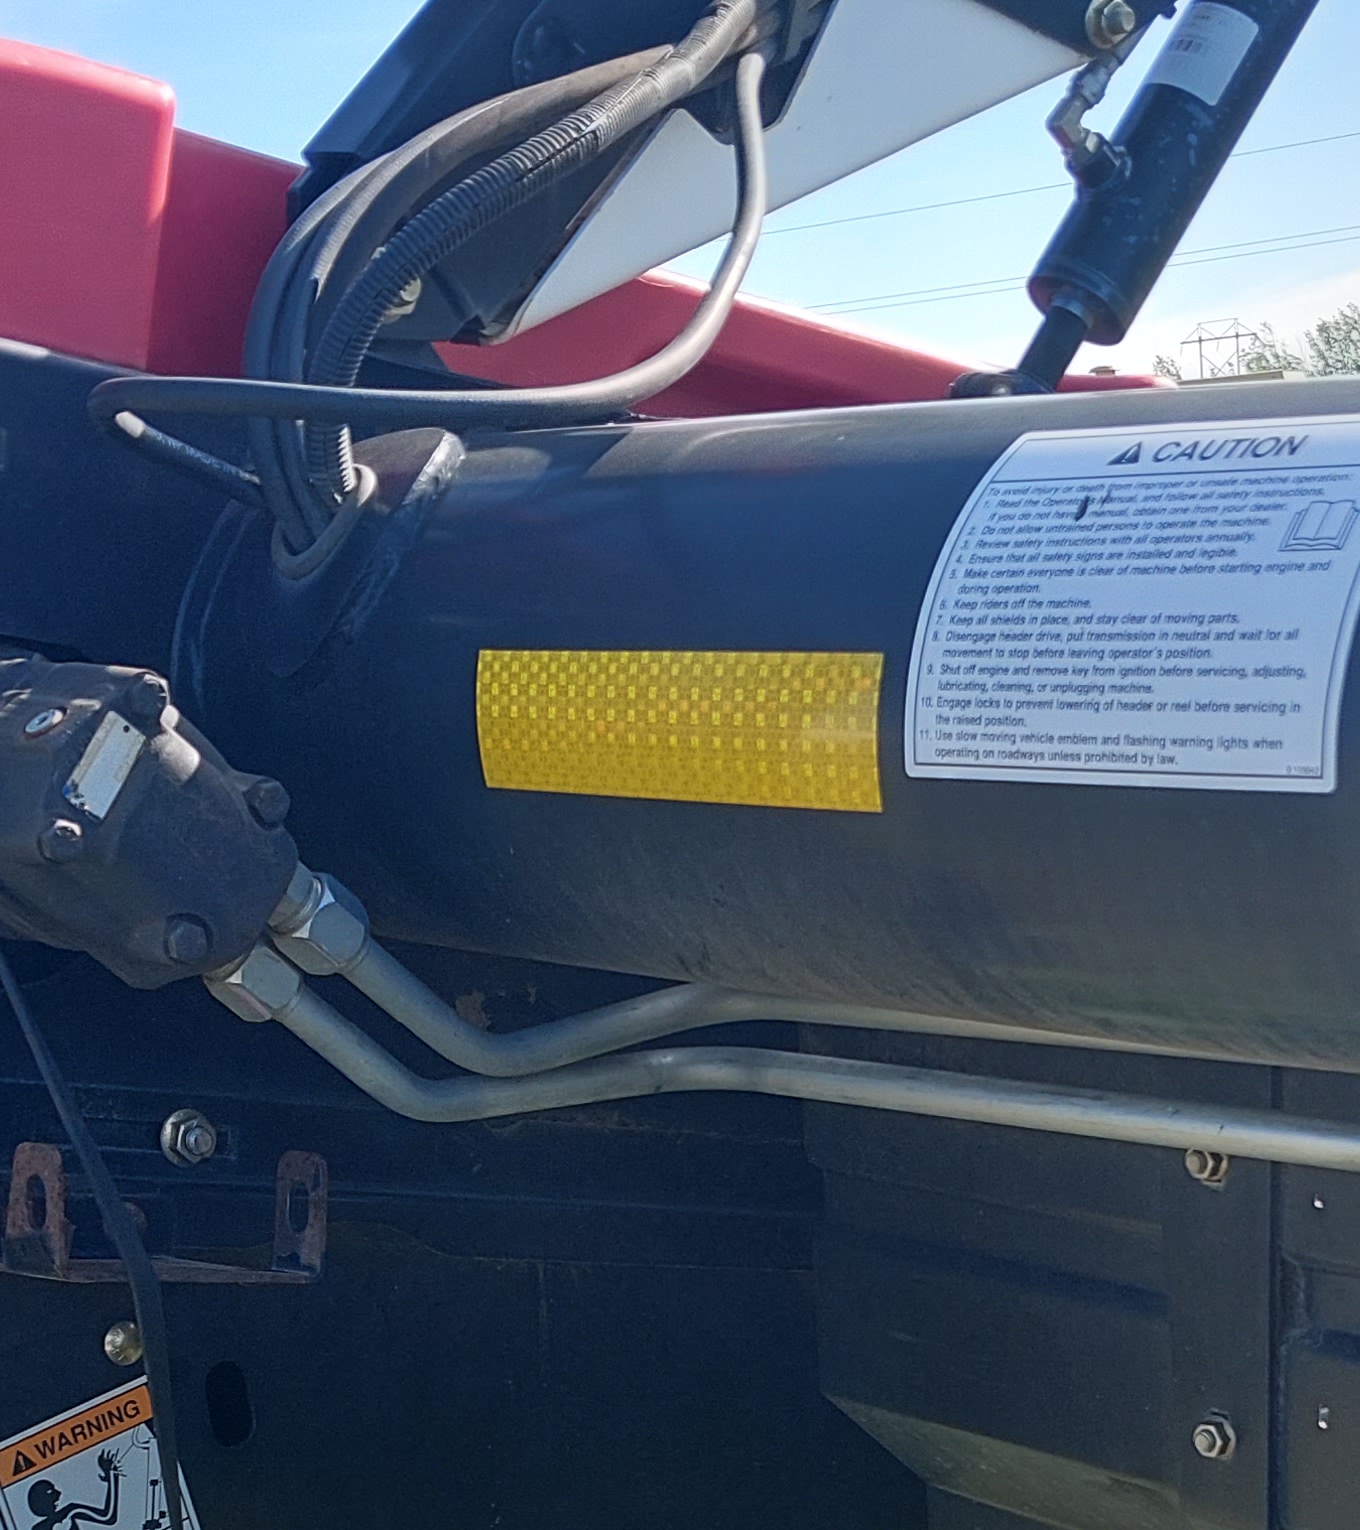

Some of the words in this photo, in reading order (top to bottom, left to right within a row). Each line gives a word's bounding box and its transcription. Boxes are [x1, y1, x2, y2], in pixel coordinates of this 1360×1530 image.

[1152, 435, 1308, 463] CAUTION
[1028, 615, 1038, 625] in
[1158, 630, 1168, 641] in
[34, 1400, 140, 1459] WARNING
